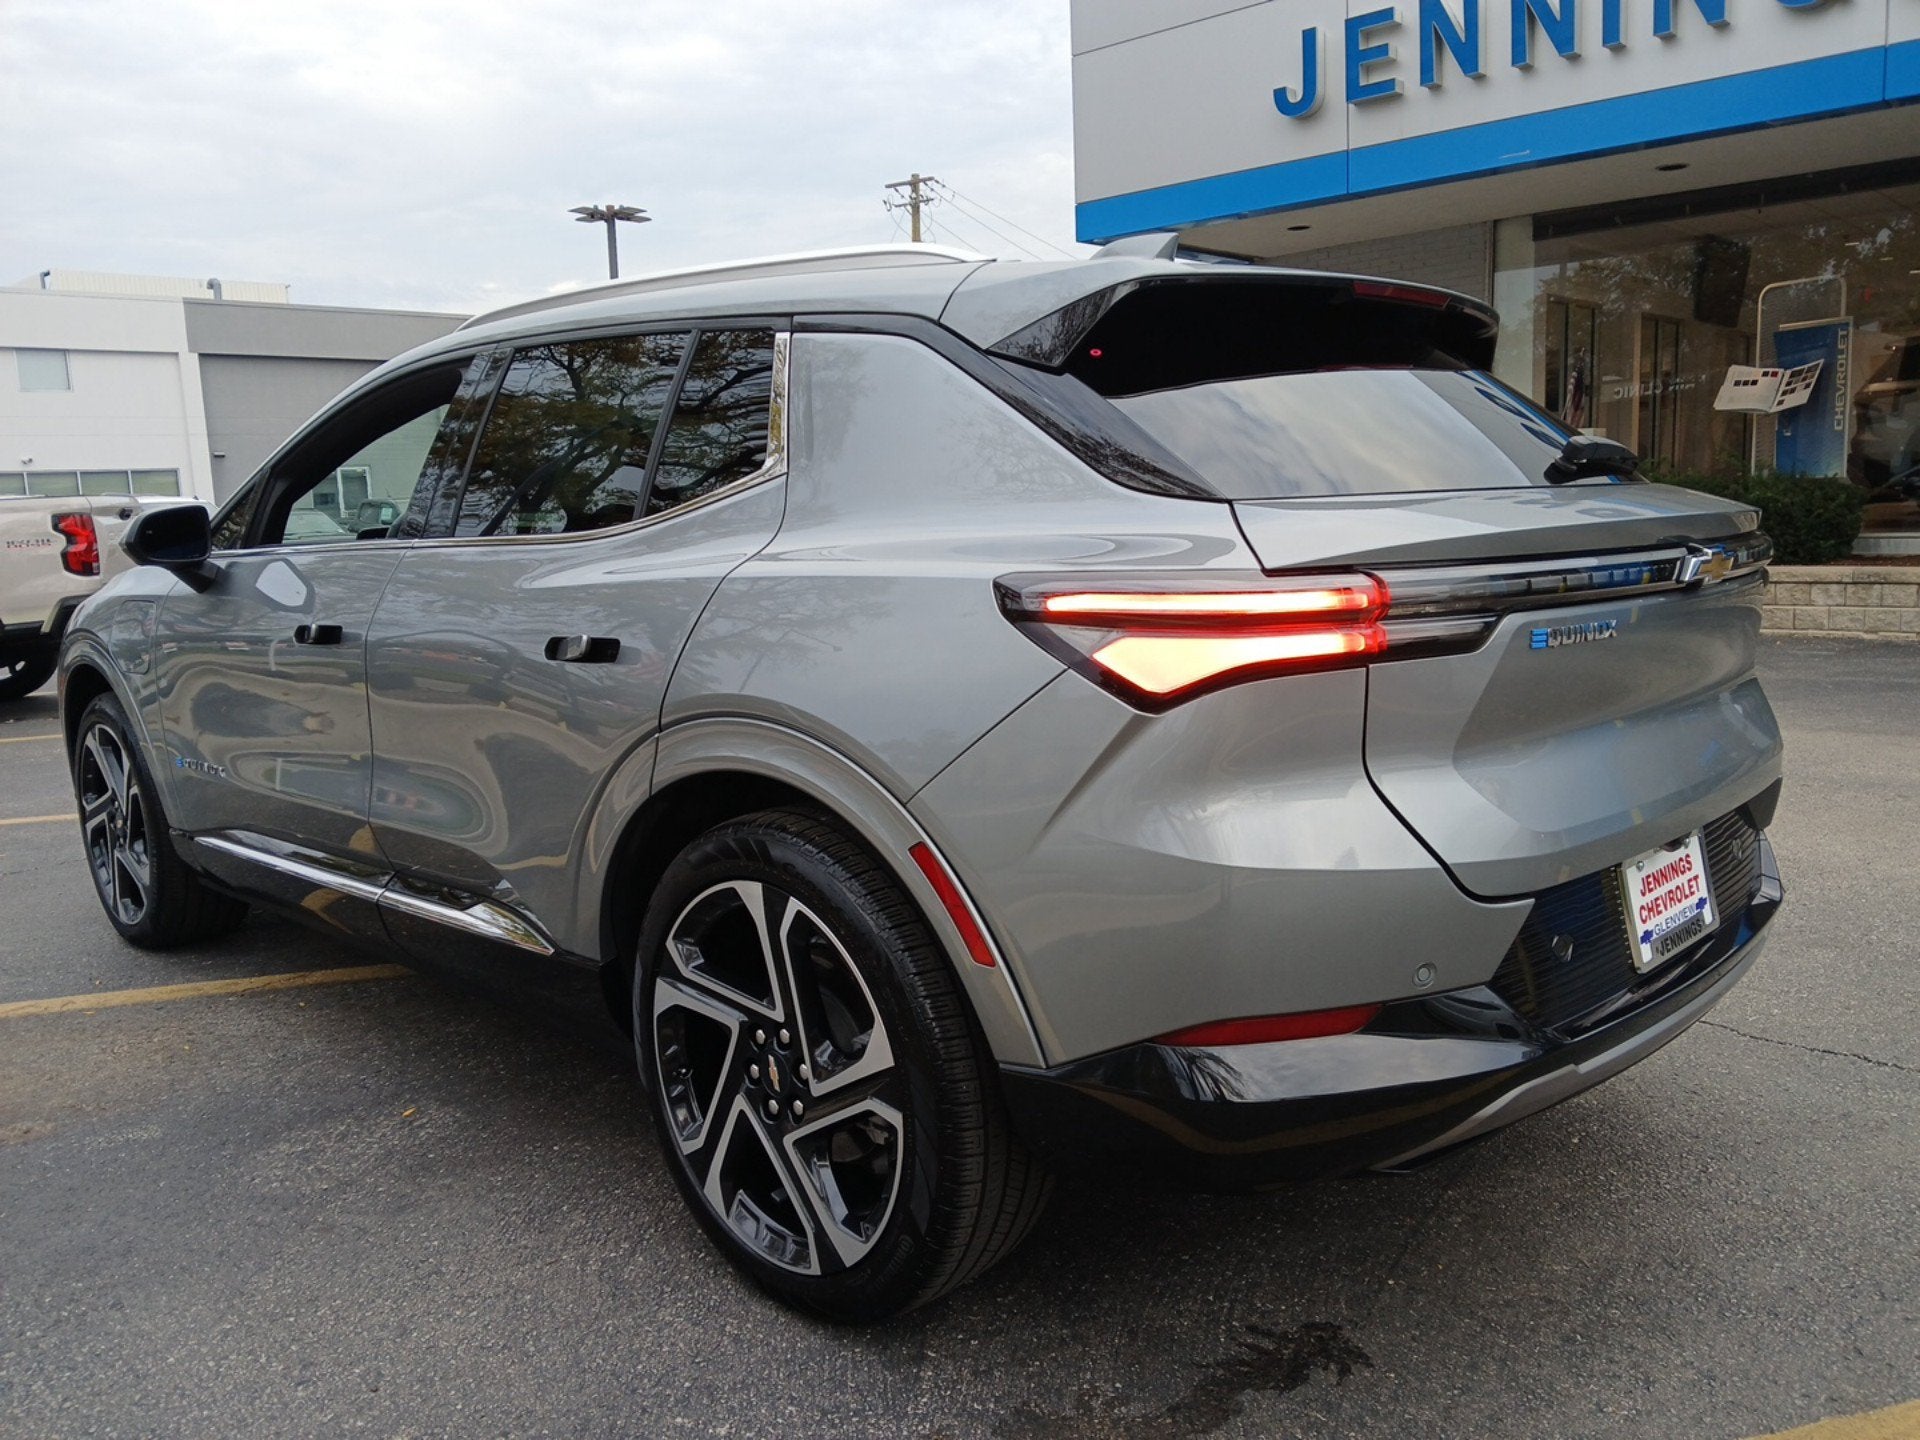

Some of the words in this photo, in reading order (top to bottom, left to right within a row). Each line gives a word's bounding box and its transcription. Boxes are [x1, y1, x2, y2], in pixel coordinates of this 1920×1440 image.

[1273, 0, 1820, 119] JENN
[1834, 328, 1848, 430] CHEVROLET
[1530, 619, 1617, 649] EQUINOX
[1640, 853, 1693, 897] JENNINGS
[1639, 874, 1700, 925] CHEVROLET
[1654, 902, 1697, 936] GLENVIEW
[1658, 918, 1703, 957] JENNINGS
